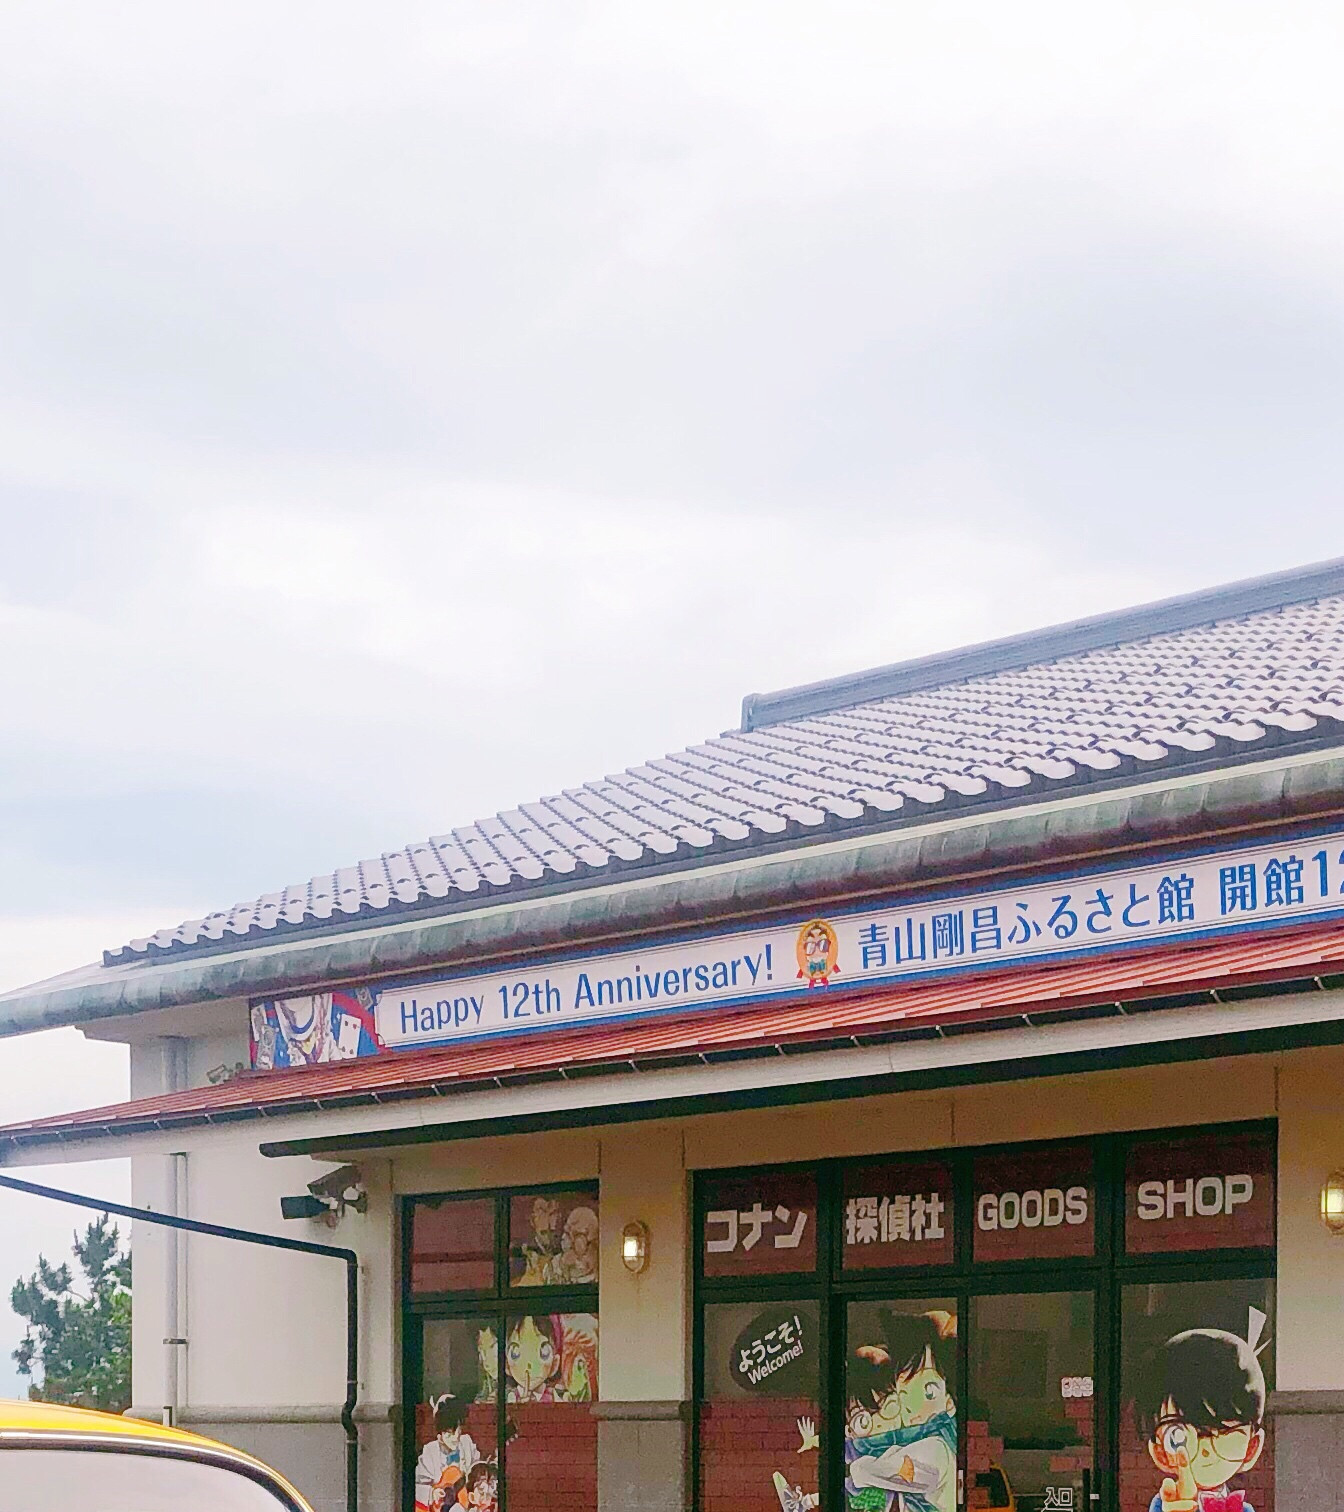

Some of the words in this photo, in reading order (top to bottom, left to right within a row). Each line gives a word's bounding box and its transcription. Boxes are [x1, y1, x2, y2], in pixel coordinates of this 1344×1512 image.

[856, 872, 1196, 970] 青山剛昌ふるさと館
[399, 994, 485, 1034] Happy
[498, 977, 562, 1020] 12th
[574, 943, 774, 1010] Anniversary!
[706, 1203, 808, 1254] コナン
[845, 1193, 946, 1245] 探偵社
[977, 1186, 1088, 1231] GOODS
[1136, 1173, 1254, 1220] SHOP
[747, 1339, 804, 1385] Welcome!
[1044, 1486, 1073, 1507] 入口
